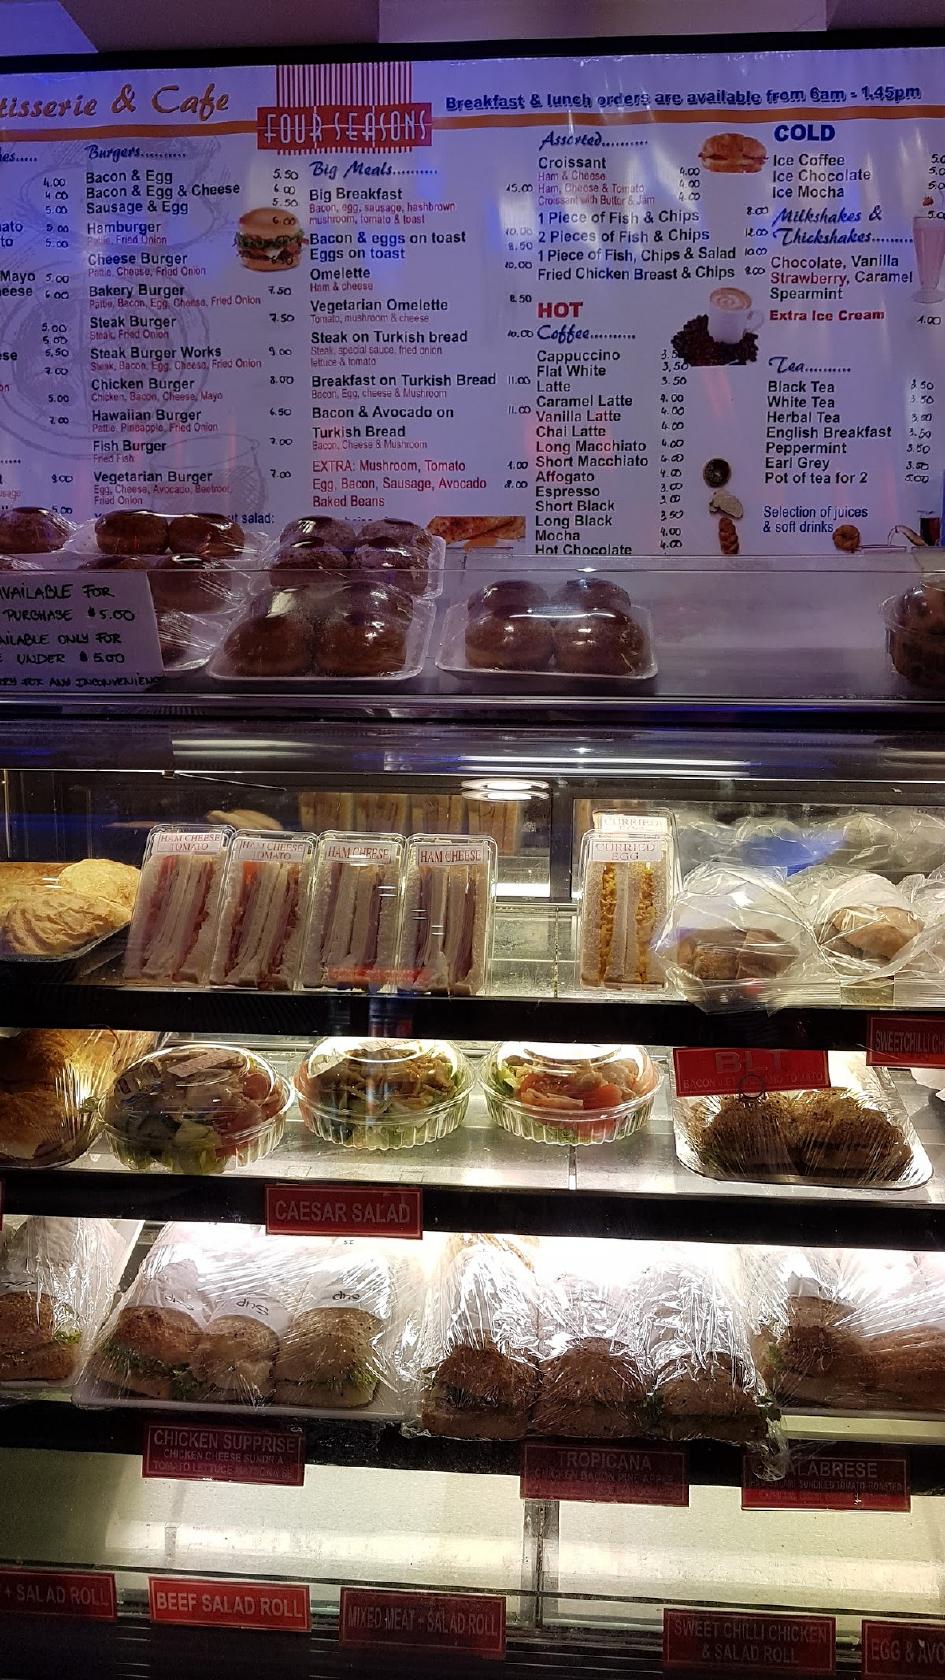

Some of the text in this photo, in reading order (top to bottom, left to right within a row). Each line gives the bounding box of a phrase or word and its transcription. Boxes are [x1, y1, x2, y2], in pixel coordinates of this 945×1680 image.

[111, 84, 136, 113] &
[152, 84, 229, 121] Cafe
[446, 86, 921, 111] Breakfast & lunch orders are available from 6am 1.45pm
[265, 110, 425, 144] FOUR SEASONS
[774, 124, 835, 141] COLD
[539, 157, 606, 168] Croissant
[773, 154, 844, 166] Ice Coffee
[86, 170, 173, 184] Bacon & Egg
[773, 169, 871, 182] Ice Chocolate
[310, 188, 402, 202] Big Breakfast
[86, 201, 189, 217] Sausage & Egg
[772, 205, 882, 227] Milkshakes &
[87, 222, 161, 235] Hamburger
[88, 253, 187, 266] Cheese Burger
[771, 255, 898, 270] Chocolate, Vanilla
[310, 268, 370, 279] Omelette
[539, 267, 734, 280] Fried Chicken Breast & Chips
[771, 271, 913, 287] Strawberry, Caramel
[89, 284, 185, 300] Bakery Burger
[770, 288, 843, 301] Spearmint
[311, 299, 447, 314] Vegetarian Omelette
[538, 302, 583, 318] HOT
[770, 311, 884, 320] Extra Ice Cream
[537, 351, 620, 362] Cappuccino
[537, 365, 606, 377] Flat White
[91, 378, 195, 391] Chicken Burger
[312, 374, 496, 387] Breakfast on Turkish Bread
[537, 382, 570, 392] Latte
[768, 381, 834, 392] Black Tea
[537, 396, 632, 407] Caramel Latte
[92, 410, 201, 422] Hawaiian Burger
[767, 426, 892, 440] English Breakfast
[766, 442, 847, 455] Peppermint
[313, 460, 465, 473] EXTRA: Mushroom, Tomato
[765, 457, 830, 471] Earl Grey
[94, 471, 212, 484] Vegetarian Burger
[536, 472, 594, 484] Affogato
[765, 472, 868, 483] Pot of tea for 2
[313, 478, 487, 491] Egg, Bacon, Sausage, Avocado
[536, 487, 600, 497] Espresso
[313, 496, 384, 507] Baked Beans
[764, 506, 868, 520] Selection of juices
[763, 521, 833, 532] & soft drinks
[536, 531, 580, 541] Mocha
[82, 585, 114, 598] FOR
[3, 609, 72, 621] PURCHASE
[58, 635, 88, 644] ONLY
[96, 633, 121, 644] FOR
[17, 654, 65, 664] UNDER
[421, 851, 480, 862] HAM CHEESE
[276, 1200, 410, 1223] CAESAR SALAD
[154, 1430, 218, 1448] CHICKEN
[559, 1451, 651, 1470] TROPICANA
[16, 1584, 110, 1606] SALAD ROLL
[157, 1592, 303, 1617] BEEF SALAD ROLL
[350, 1606, 497, 1635] MIXED MEAT SALAD ROLL
[675, 1621, 826, 1642] SWEET CHILLI CHICKEN
[702, 1645, 798, 1663] & SALAD ROLL
[872, 1639, 900, 1660] EGG
[906, 1640, 913, 1662] &
